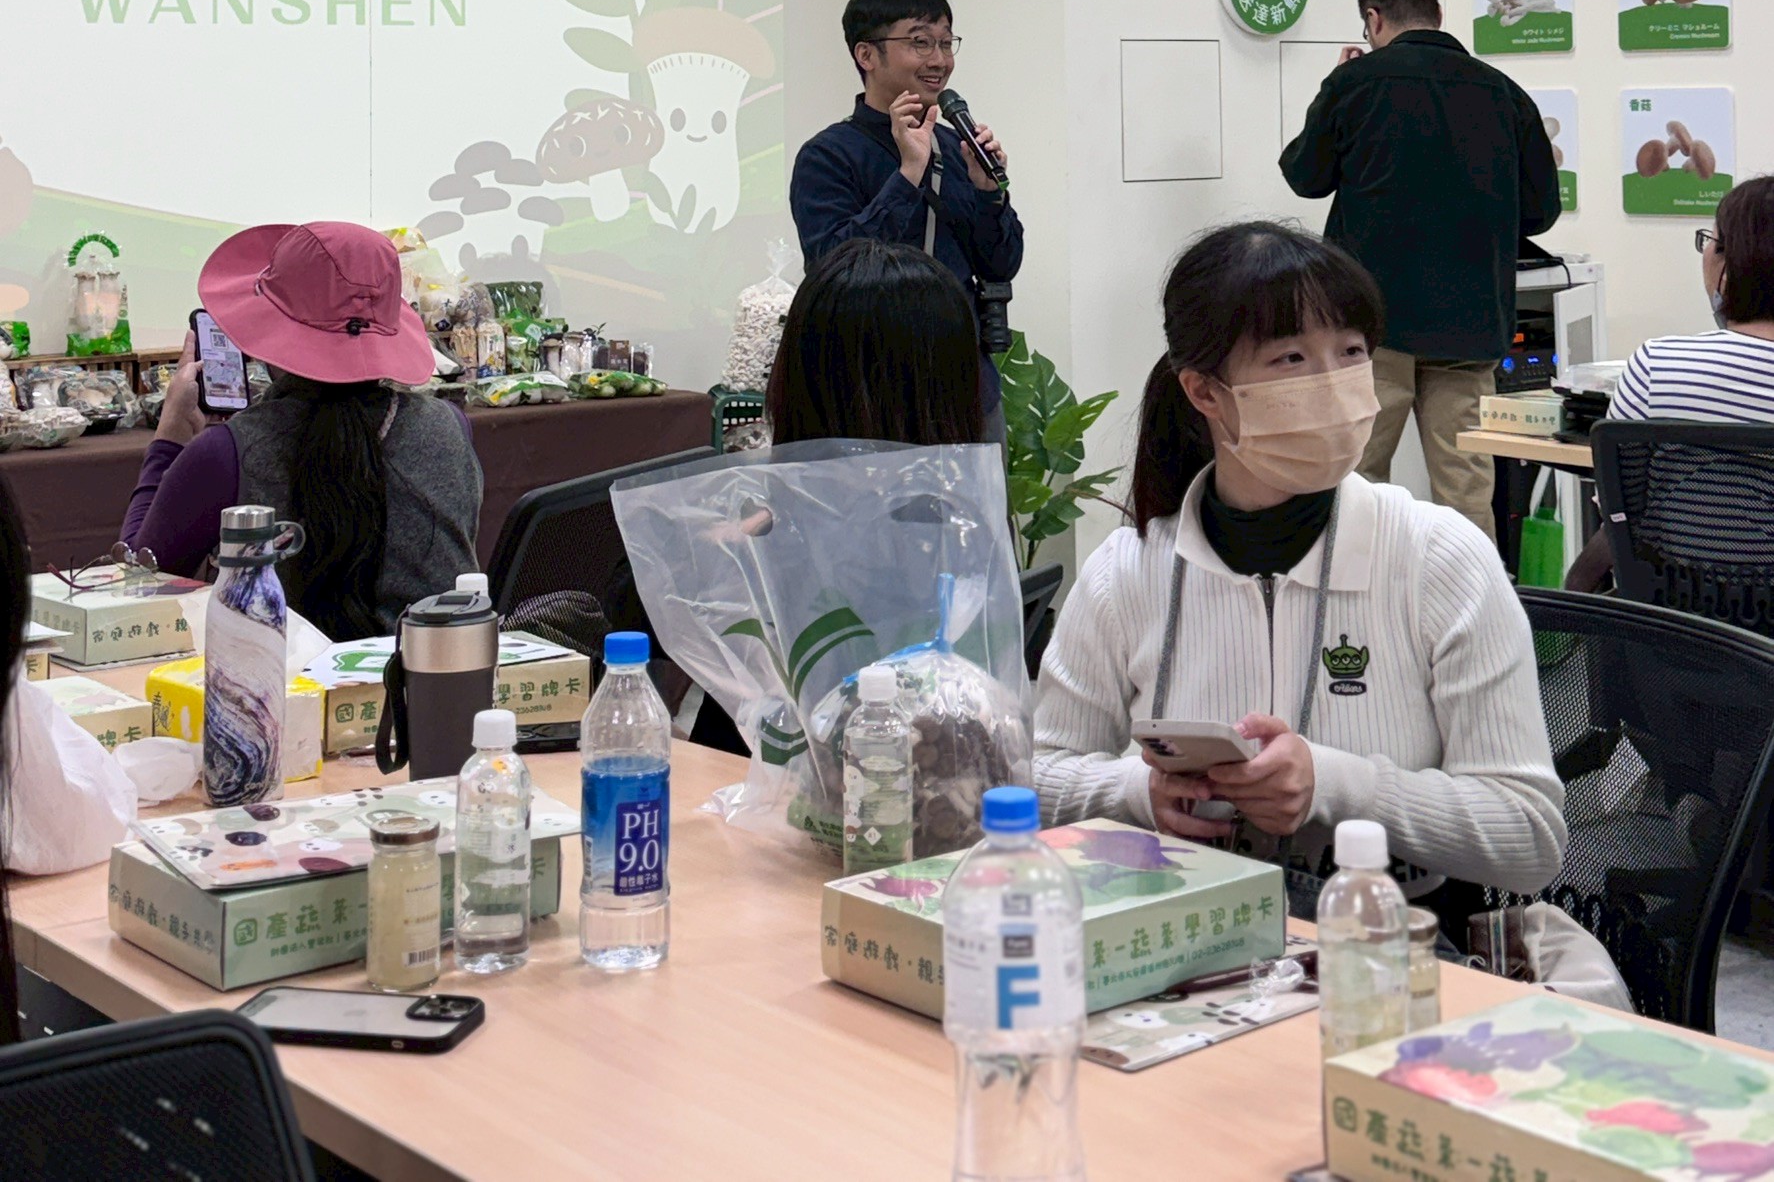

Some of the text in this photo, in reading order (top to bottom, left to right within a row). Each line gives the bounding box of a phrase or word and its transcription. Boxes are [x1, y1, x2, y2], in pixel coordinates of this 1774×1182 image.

[1629, 99, 1652, 112] 香菇
[621, 809, 659, 839] PH
[619, 839, 660, 874] 9.0
[997, 965, 1041, 1030] F
